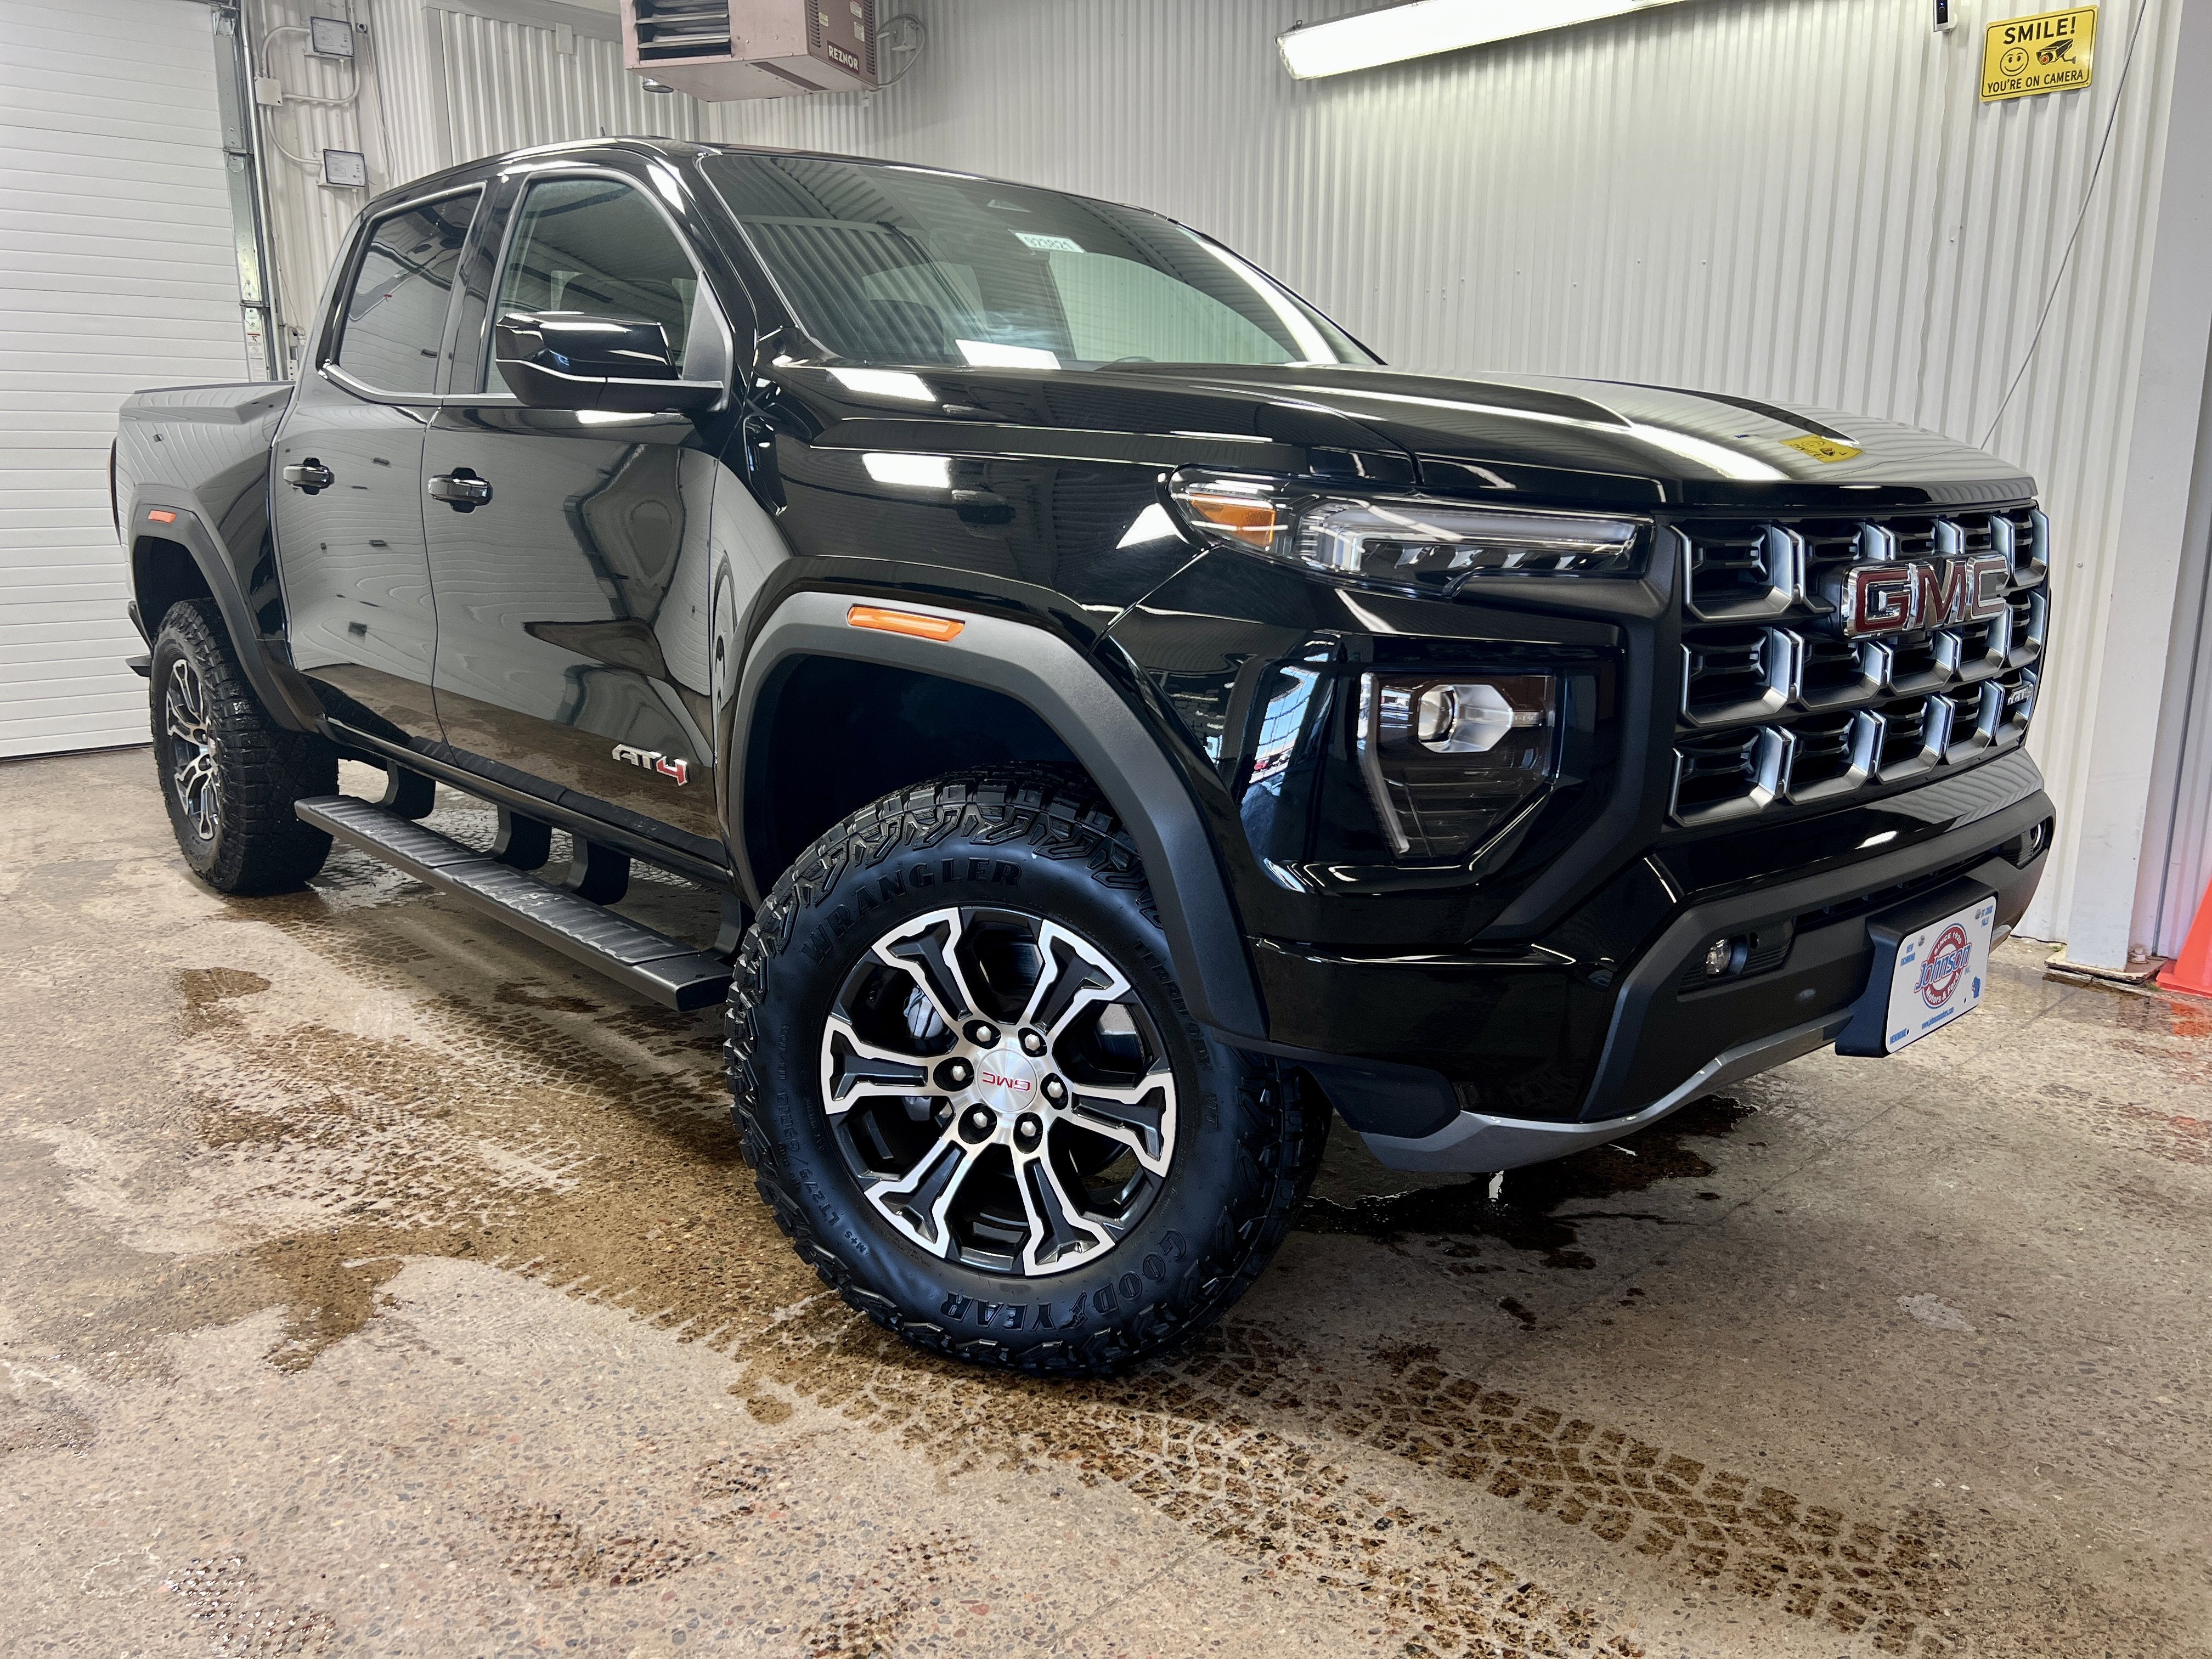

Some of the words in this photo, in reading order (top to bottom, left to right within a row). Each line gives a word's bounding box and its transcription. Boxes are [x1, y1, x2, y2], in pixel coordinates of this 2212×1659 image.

[2002, 16, 2076, 45] SMILE!
[828, 44, 859, 71] REZNOR
[1987, 78, 2022, 94] YOU'RE
[2026, 75, 2040, 87] ON
[2043, 69, 2084, 84] CAMERA
[1841, 554, 2008, 640] GMC
[612, 743, 690, 786] AT4
[799, 857, 1023, 964] WRANGLER
[1934, 932, 1951, 955] SINCE
[1915, 943, 1971, 992] Johnson
[1925, 986, 1942, 1004] Motors
[1942, 990, 1947, 1001] &
[1947, 971, 1960, 995] Ford
[982, 1071, 1031, 1092] GMC
[844, 1230, 867, 1254] M+S
[939, 1228, 1187, 1331] GOODYEAR
